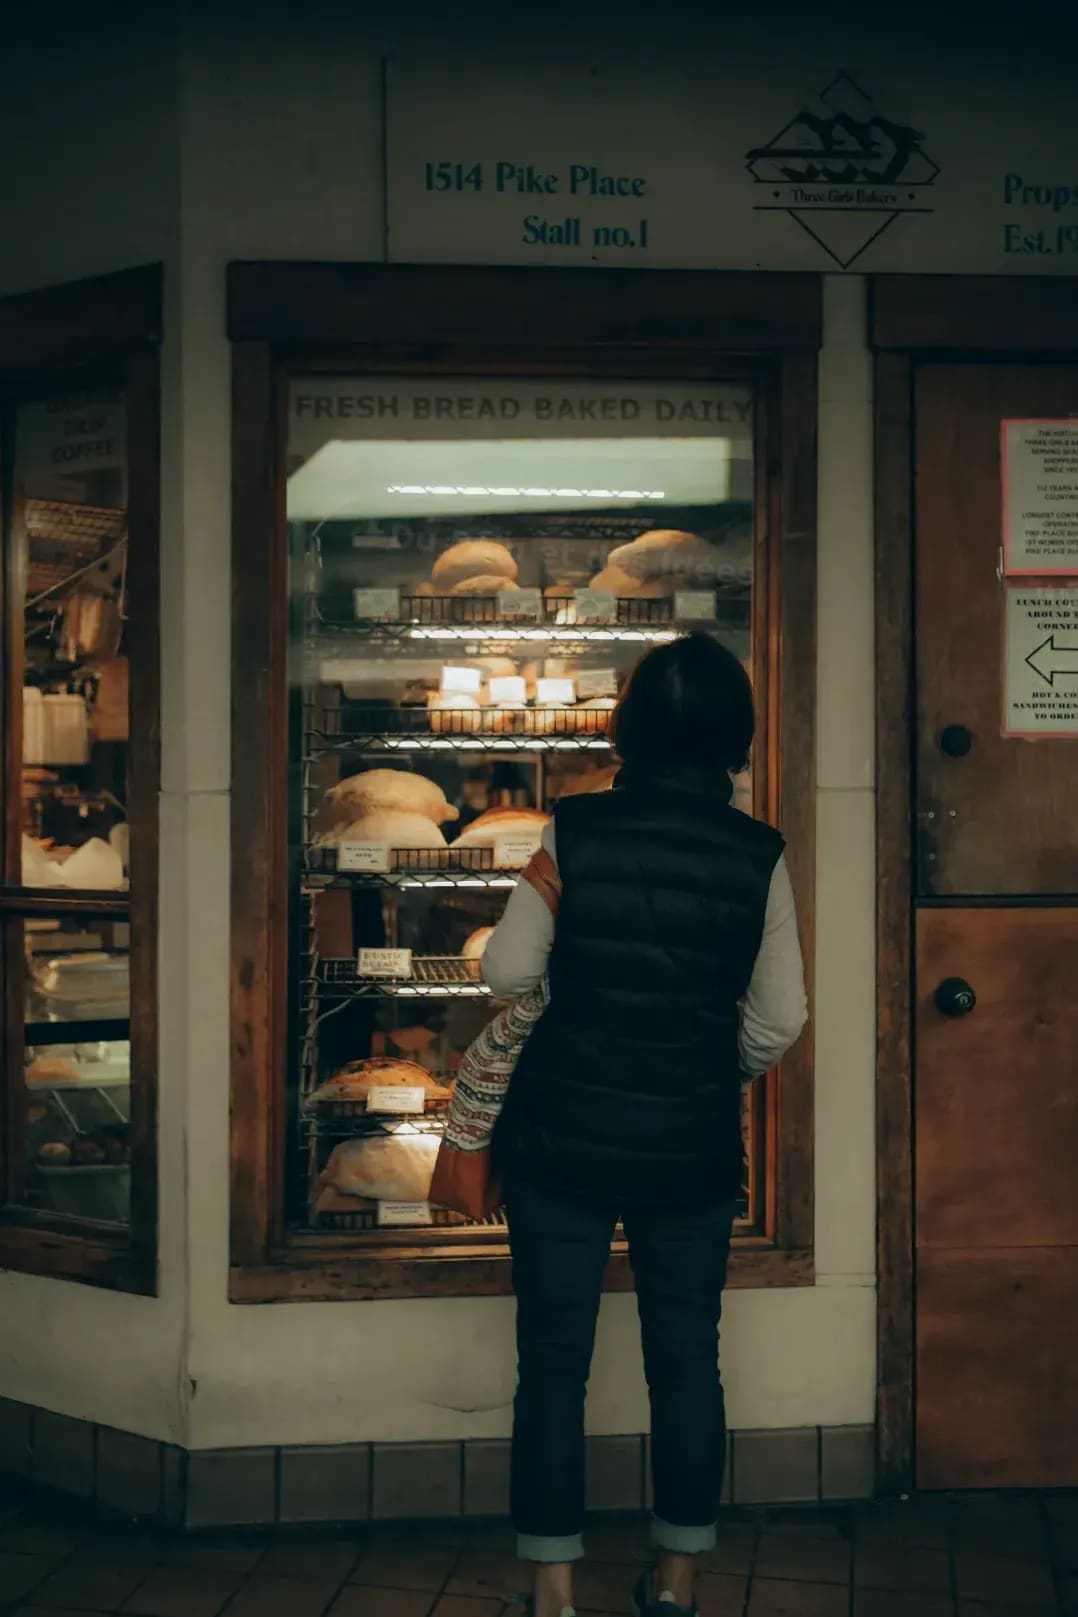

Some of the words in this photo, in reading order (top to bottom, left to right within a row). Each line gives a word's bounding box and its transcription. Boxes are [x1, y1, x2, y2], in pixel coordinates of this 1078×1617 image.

[425, 162, 482, 191] 1514
[496, 162, 558, 194] Pike
[569, 164, 646, 197] Place
[793, 188, 824, 202] Three
[522, 214, 580, 246] Stall
[593, 219, 648, 248] no.1
[295, 395, 399, 420] FRESH
[413, 396, 520, 421] BREAD
[534, 397, 640, 422] BAKED
[655, 399, 752, 424] DAILY
[50, 439, 113, 464] COFFEE
[1025, 610, 1071, 618] AROUND
